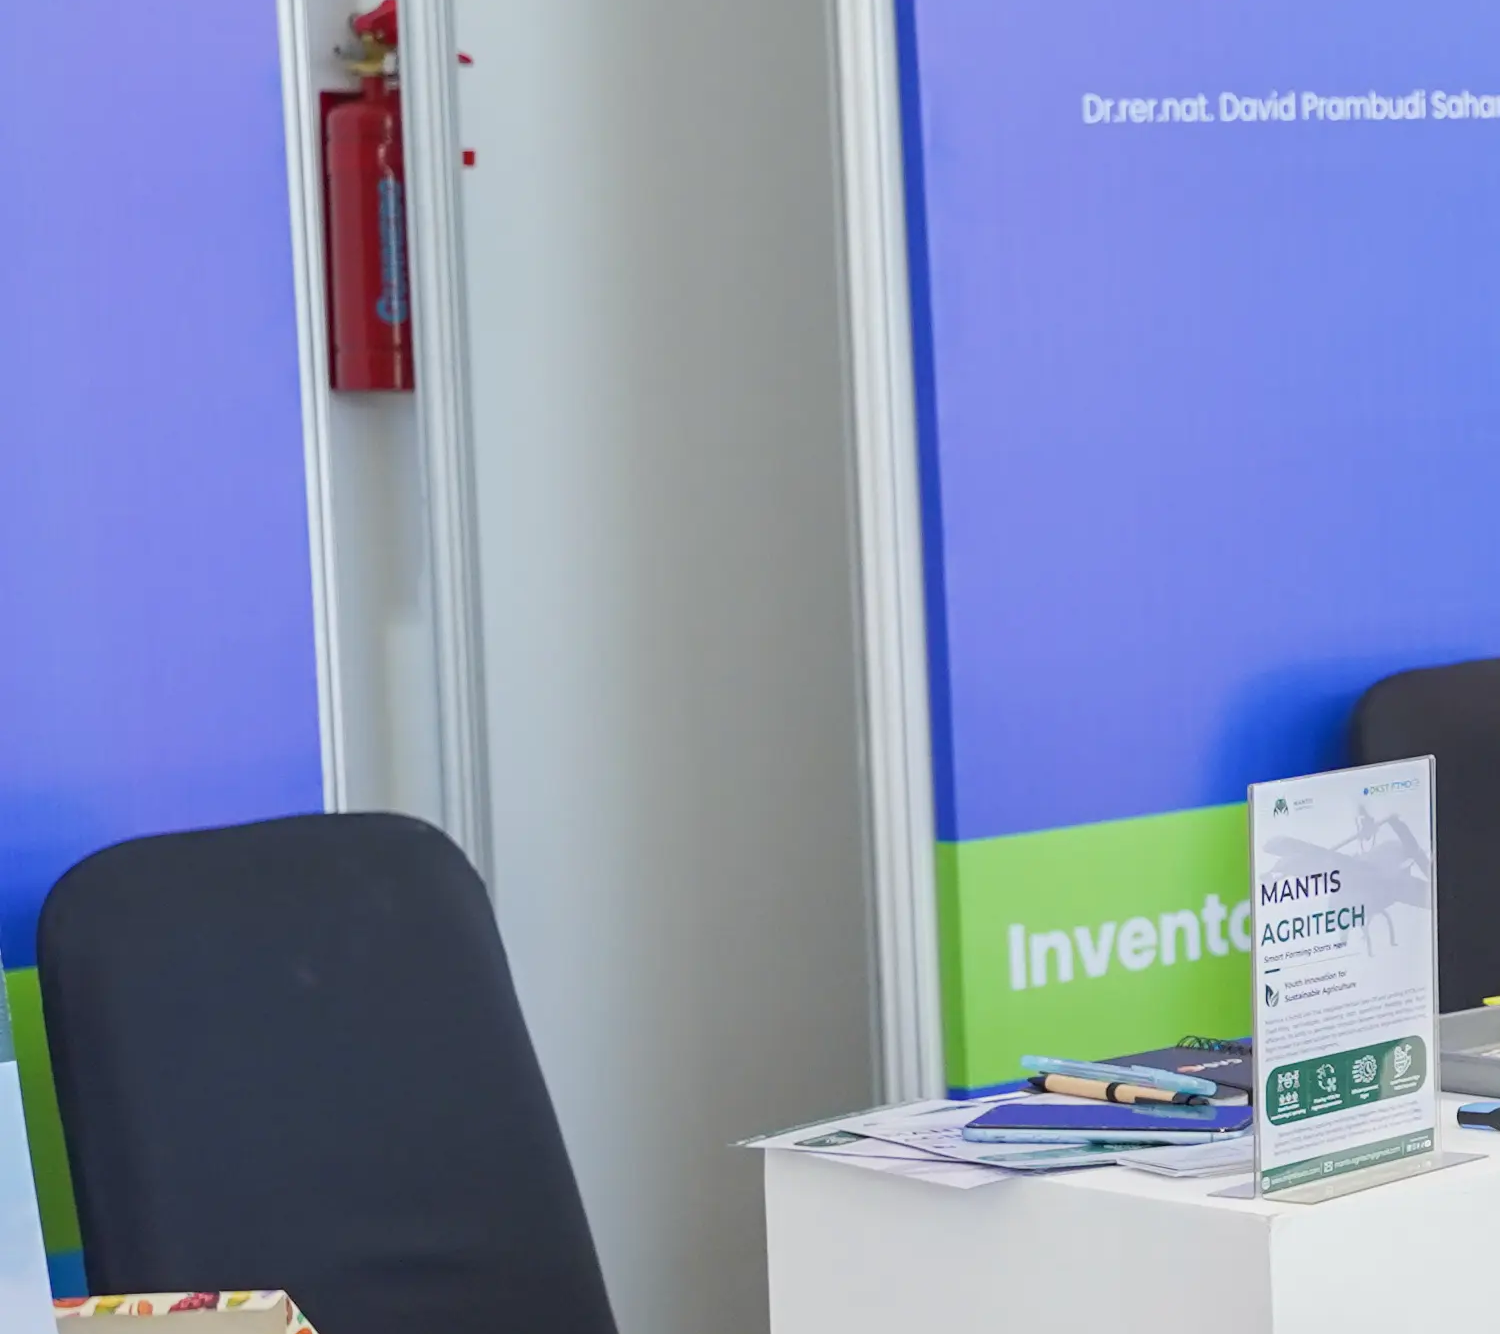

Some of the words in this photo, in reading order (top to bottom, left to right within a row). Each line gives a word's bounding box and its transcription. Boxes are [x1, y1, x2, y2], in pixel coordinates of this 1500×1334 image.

[1218, 90, 1296, 122] David
[1301, 89, 1426, 122] Prambudi
[1261, 870, 1341, 907] MANTIS
[1261, 904, 1365, 947] AGRITECH
[1264, 952, 1284, 964] Smart
[1285, 946, 1312, 961] Farming
[1313, 943, 1331, 954] Starts
[1284, 979, 1303, 990] Youth
[1304, 971, 1336, 986] Innovation
[1284, 989, 1320, 1003] Sustainable
[1322, 982, 1357, 995] Agriculture
